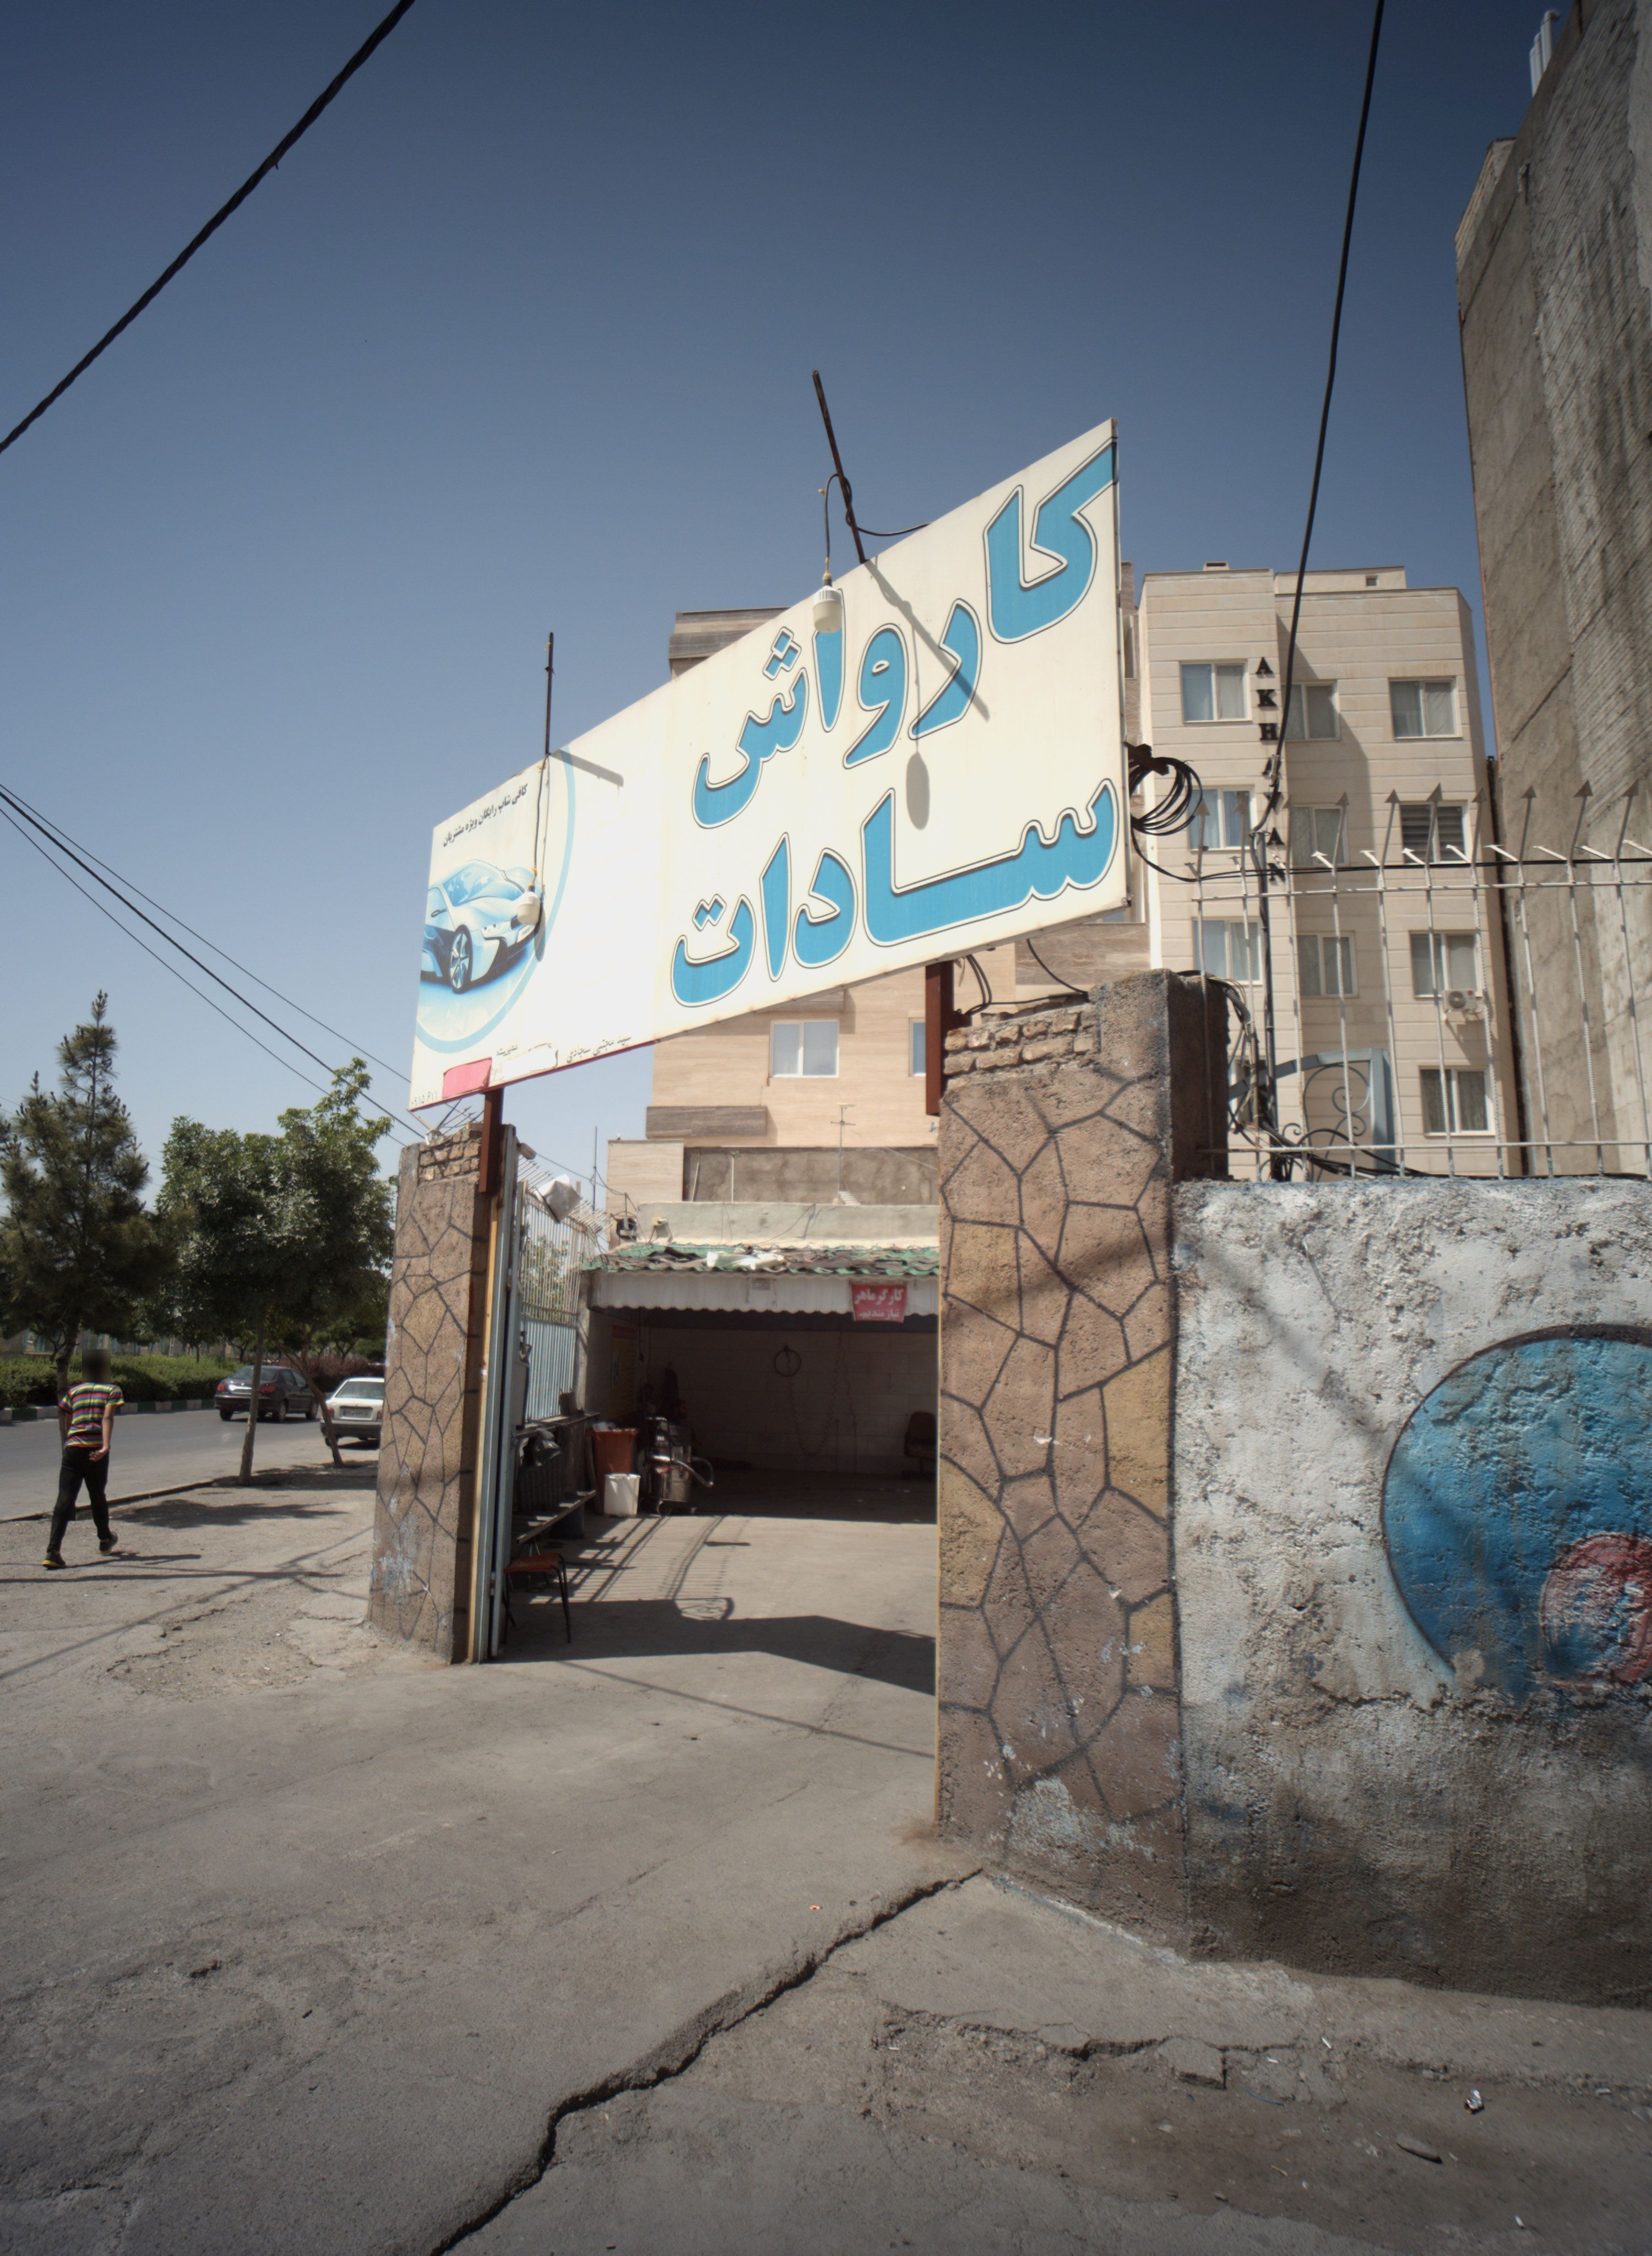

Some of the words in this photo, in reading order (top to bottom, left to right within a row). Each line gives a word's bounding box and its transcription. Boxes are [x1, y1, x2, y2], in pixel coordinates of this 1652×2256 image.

[692, 437, 1118, 829] کارواش
[512, 783, 528, 805] کافی
[498, 795, 511, 814] شاپ
[479, 804, 497, 825] رایگان
[465, 819, 477, 832] ویژه
[443, 826, 464, 847] مشتریان
[671, 778, 1118, 1007] سادات
[593, 1039, 614, 1056] مجتبی
[617, 1035, 631, 1046] سید
[567, 1046, 591, 1064] سجادی
[854, 1288, 876, 1305] ماهر
[876, 1288, 904, 1305] کارگر
